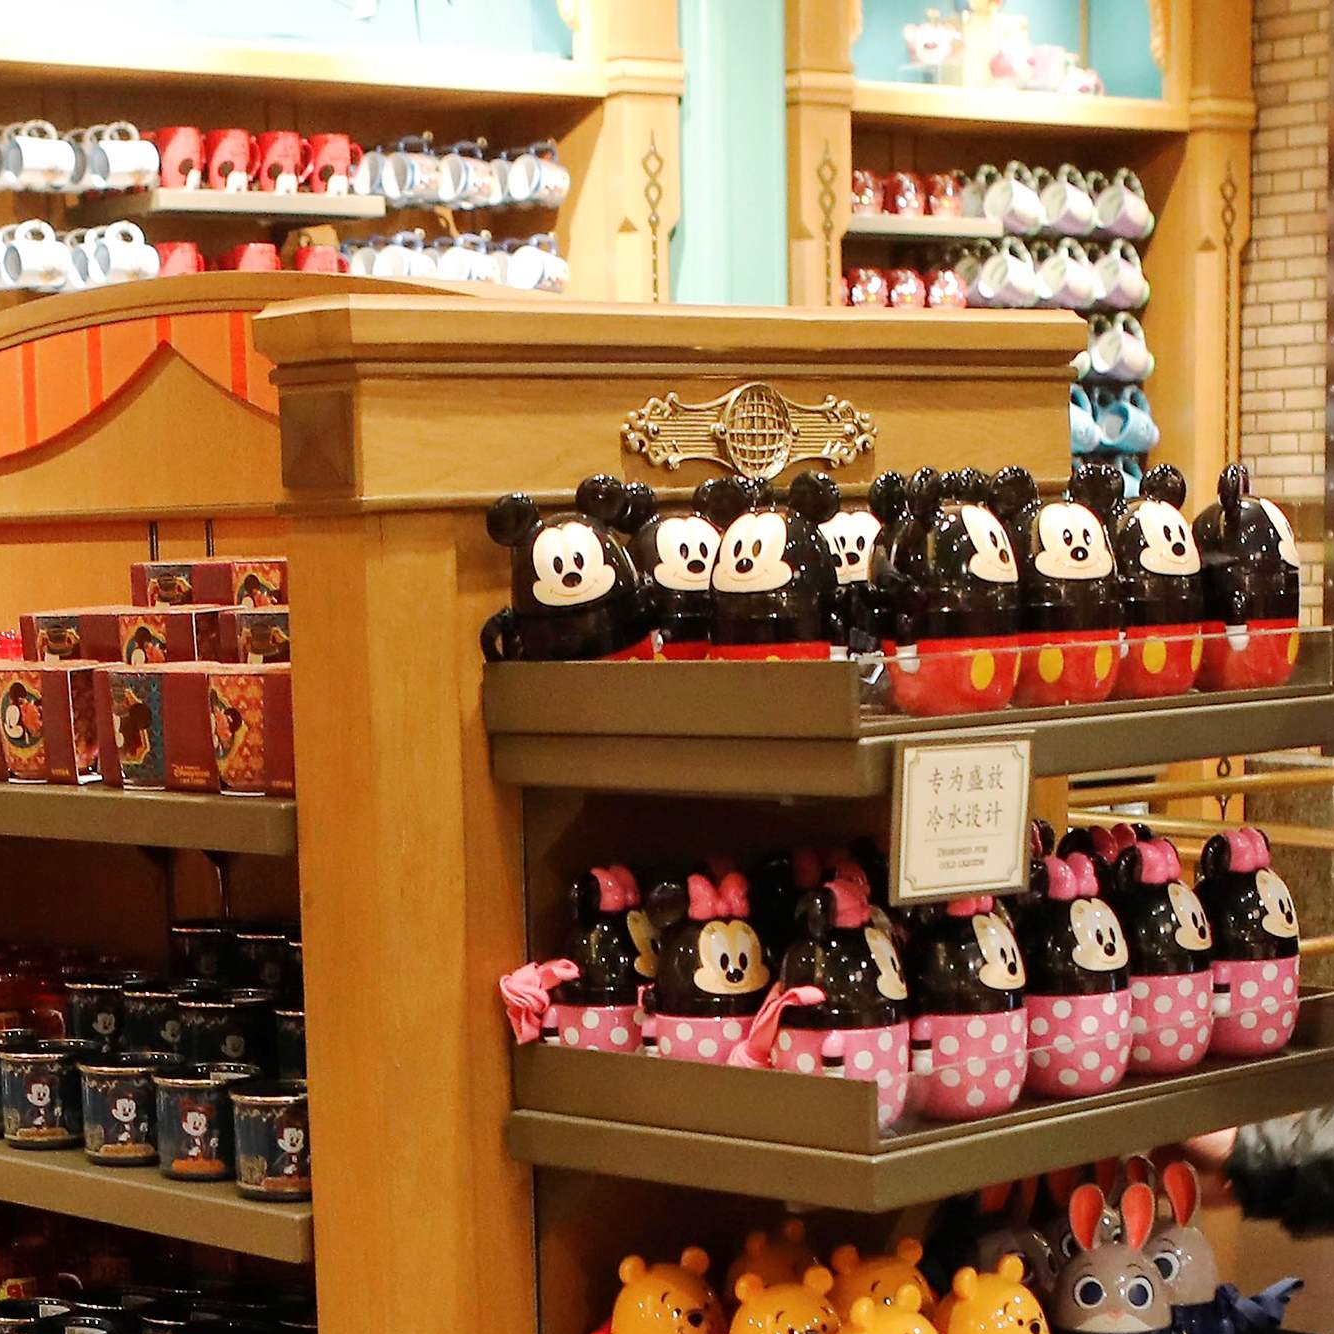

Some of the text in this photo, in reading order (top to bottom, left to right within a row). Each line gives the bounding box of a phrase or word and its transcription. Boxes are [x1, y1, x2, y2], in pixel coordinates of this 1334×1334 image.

[928, 763, 1004, 795] 专为盛放
[926, 799, 1004, 832] 冷水设计
